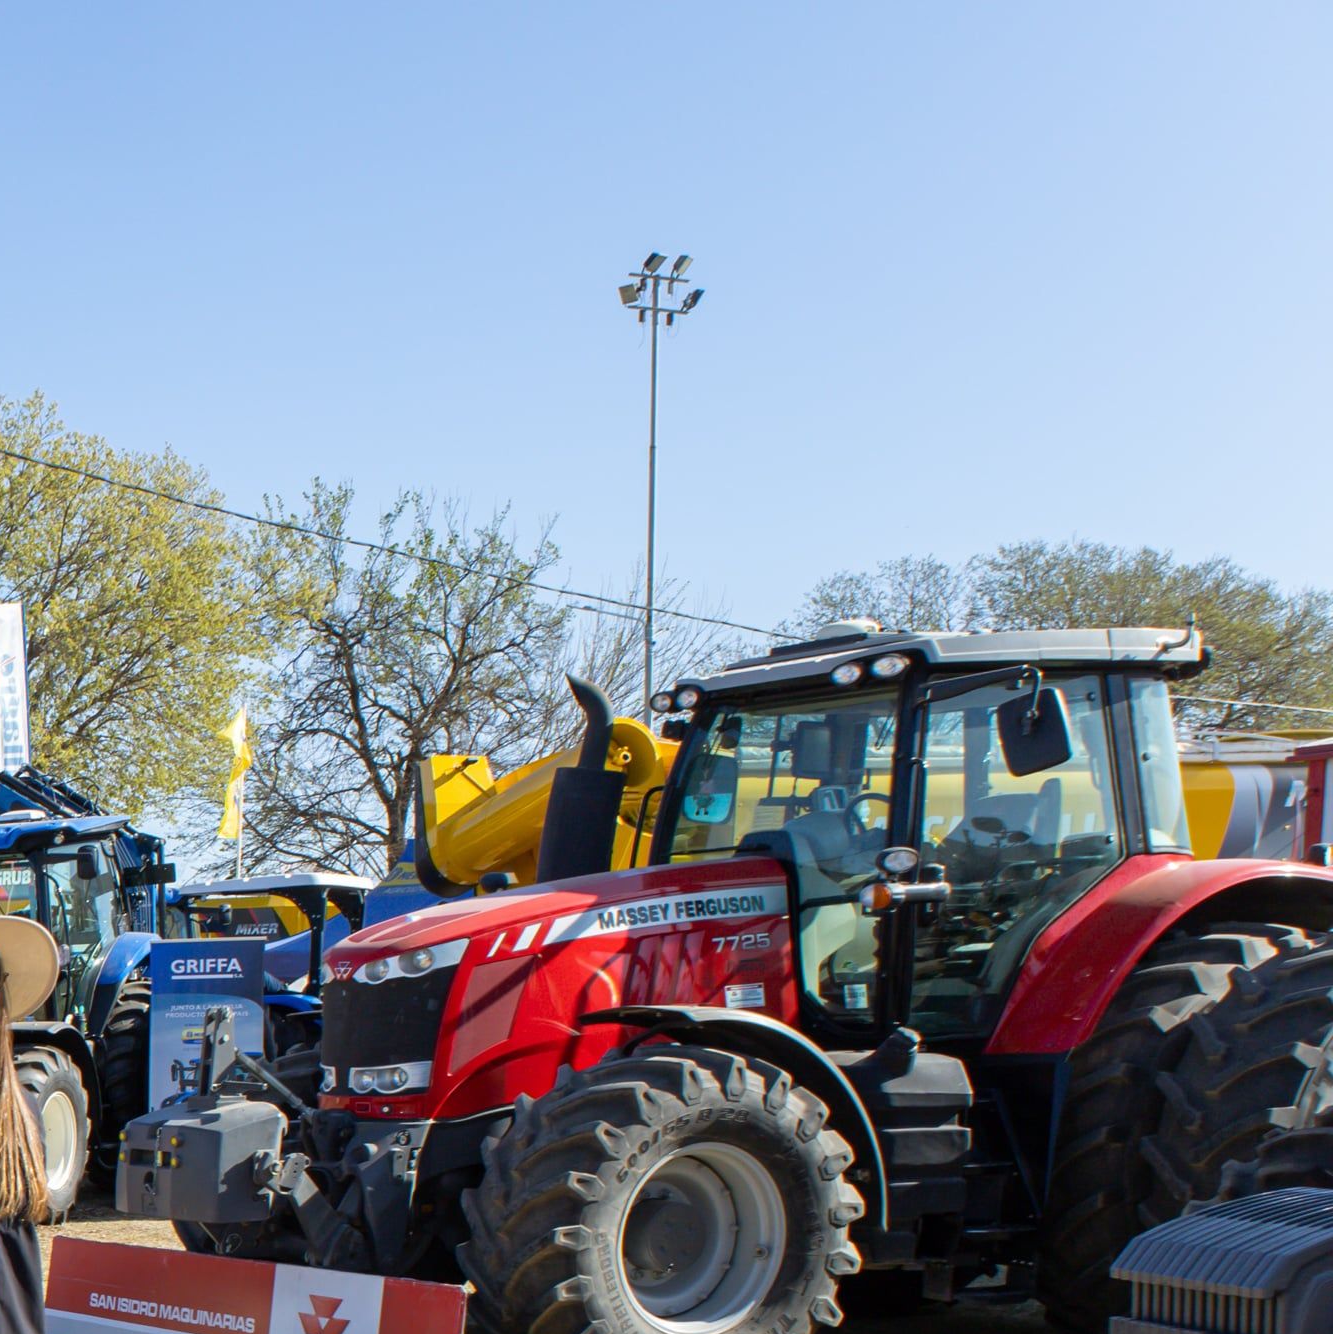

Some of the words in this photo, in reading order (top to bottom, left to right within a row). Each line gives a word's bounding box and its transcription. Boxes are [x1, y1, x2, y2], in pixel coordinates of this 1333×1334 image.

[598, 903, 669, 930] MASSEY
[675, 896, 765, 918] FERGUSON
[235, 922, 279, 936] MIXER
[711, 933, 771, 953] 7725
[171, 958, 242, 974] GRIFFA
[89, 1292, 117, 1309] SAN
[117, 1297, 158, 1318] ISIDRO
[159, 1304, 255, 1334] MAQUINARIAS
